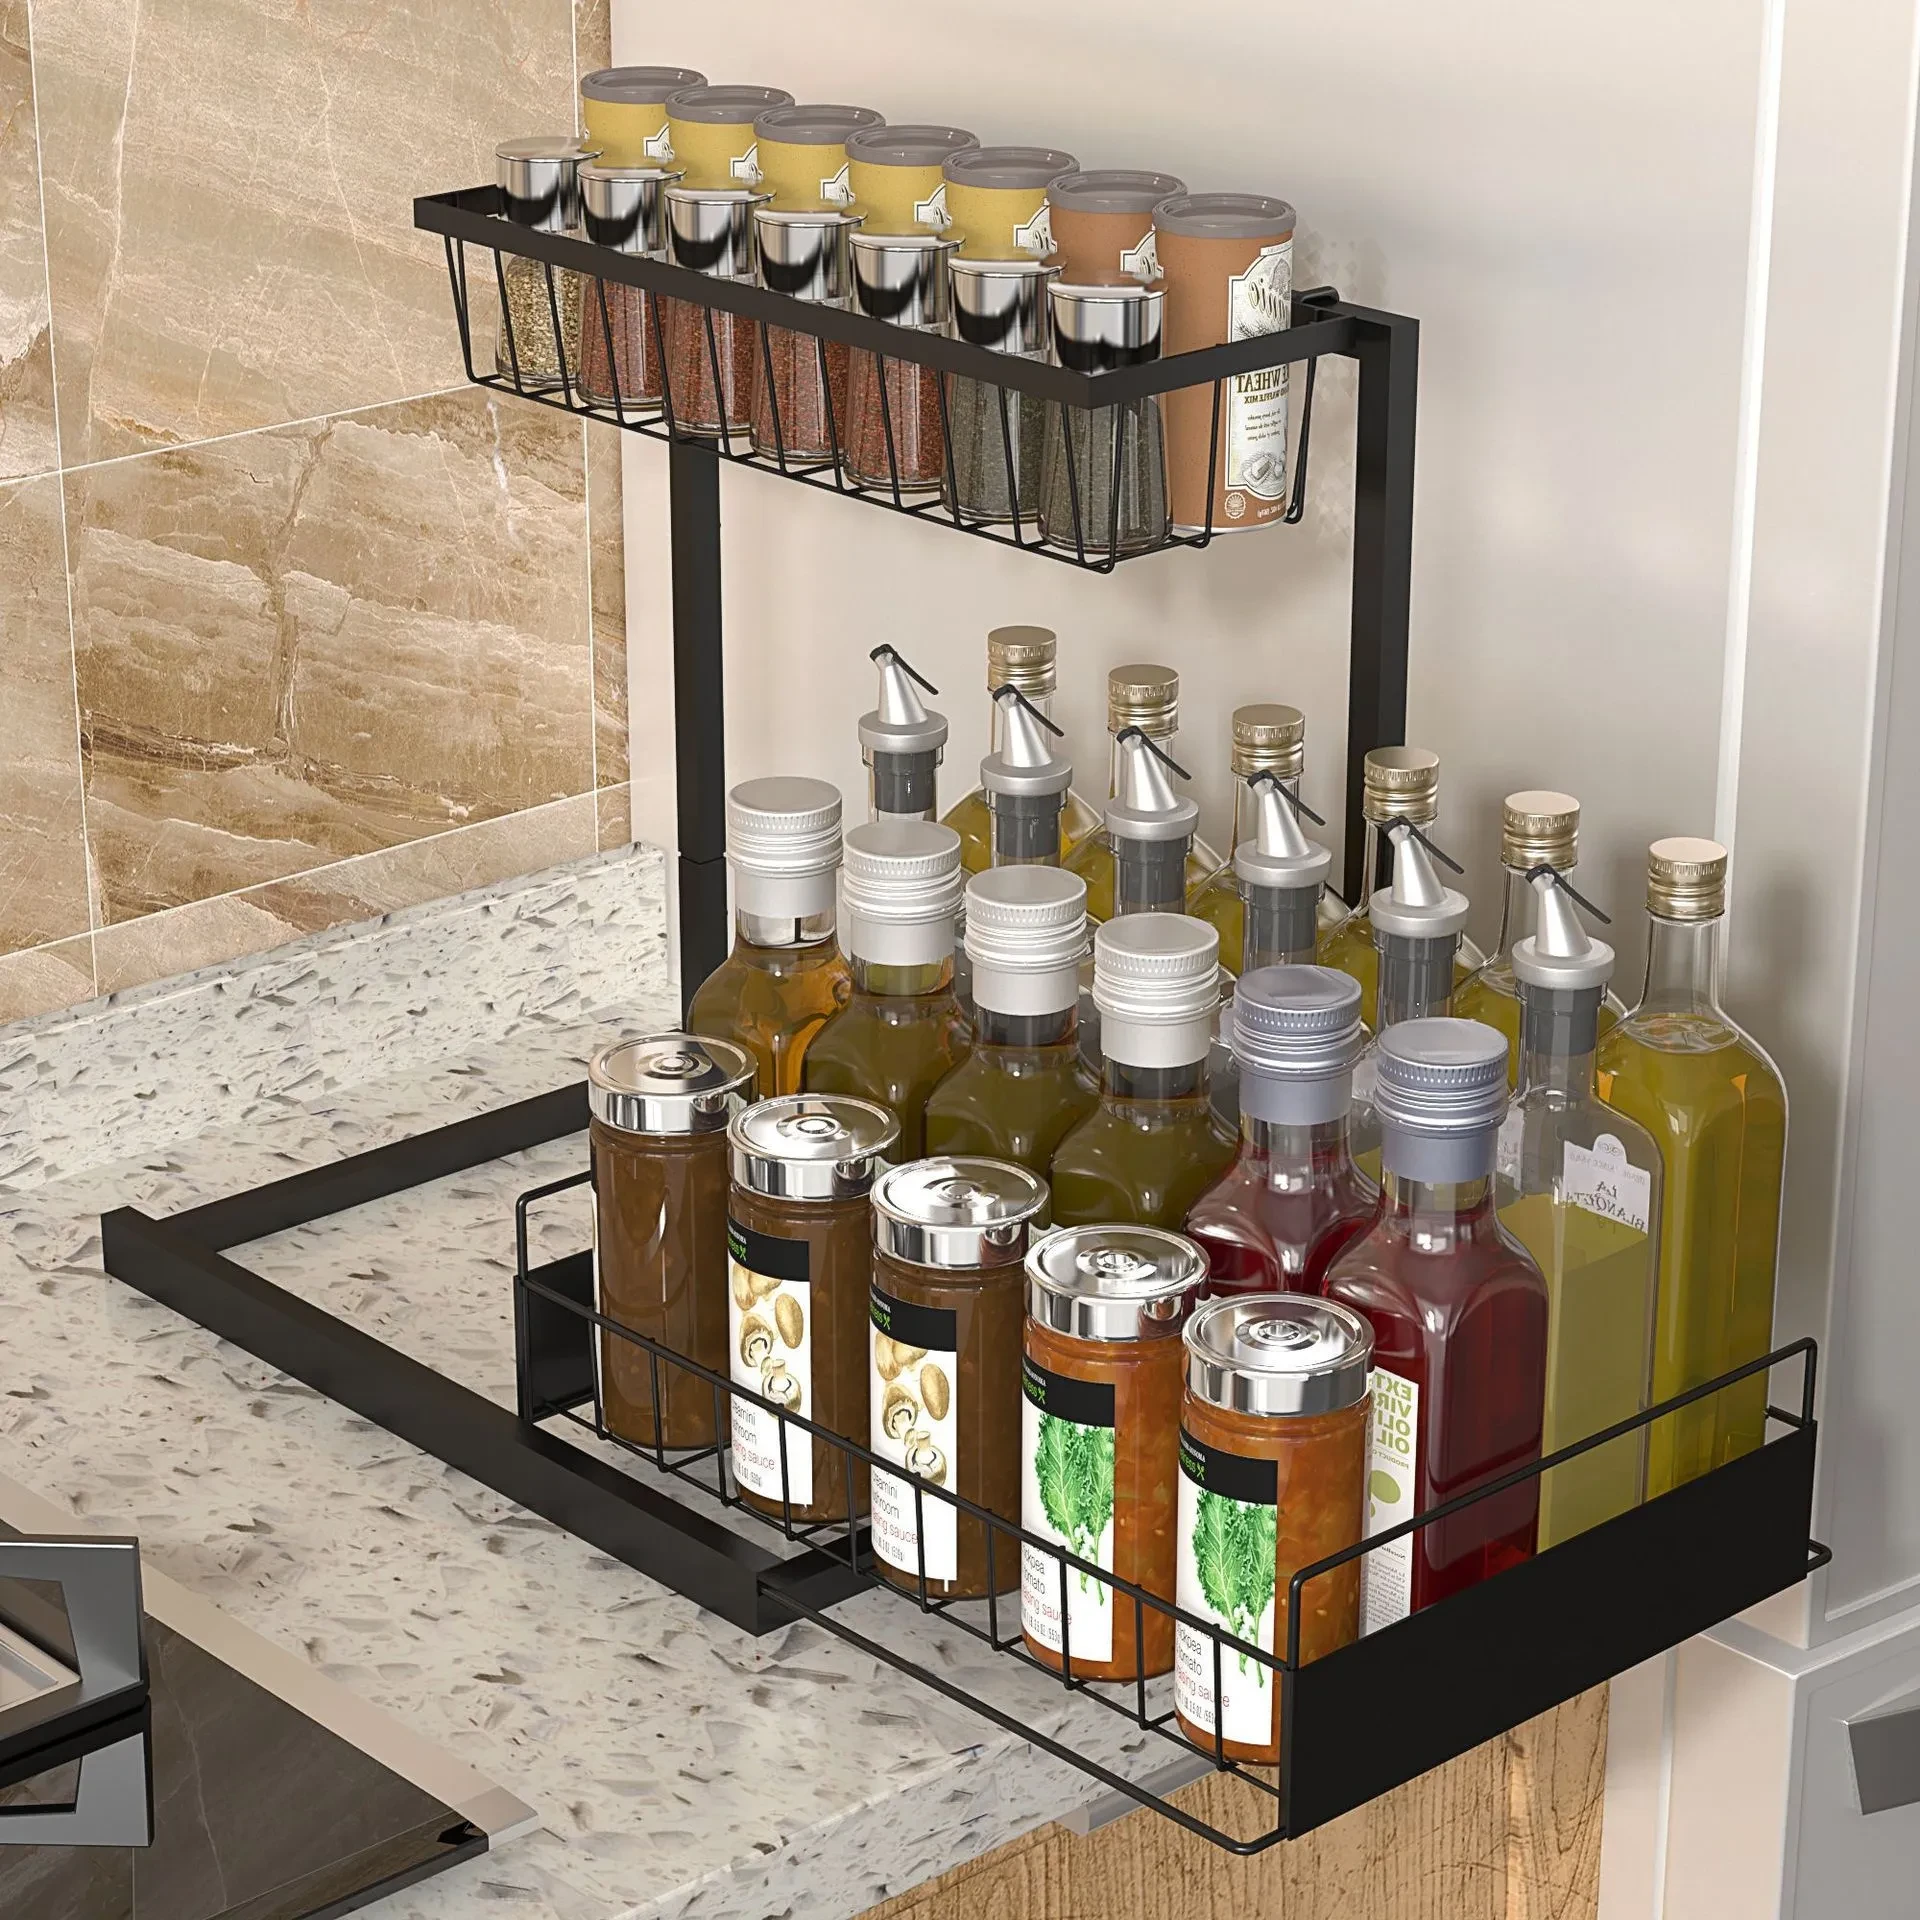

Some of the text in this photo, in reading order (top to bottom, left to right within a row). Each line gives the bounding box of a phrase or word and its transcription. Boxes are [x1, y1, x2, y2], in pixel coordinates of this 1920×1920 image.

[748, 1450, 775, 1470] sauce
[889, 1524, 918, 1545] sauce
[1198, 1685, 1230, 1708] saue
